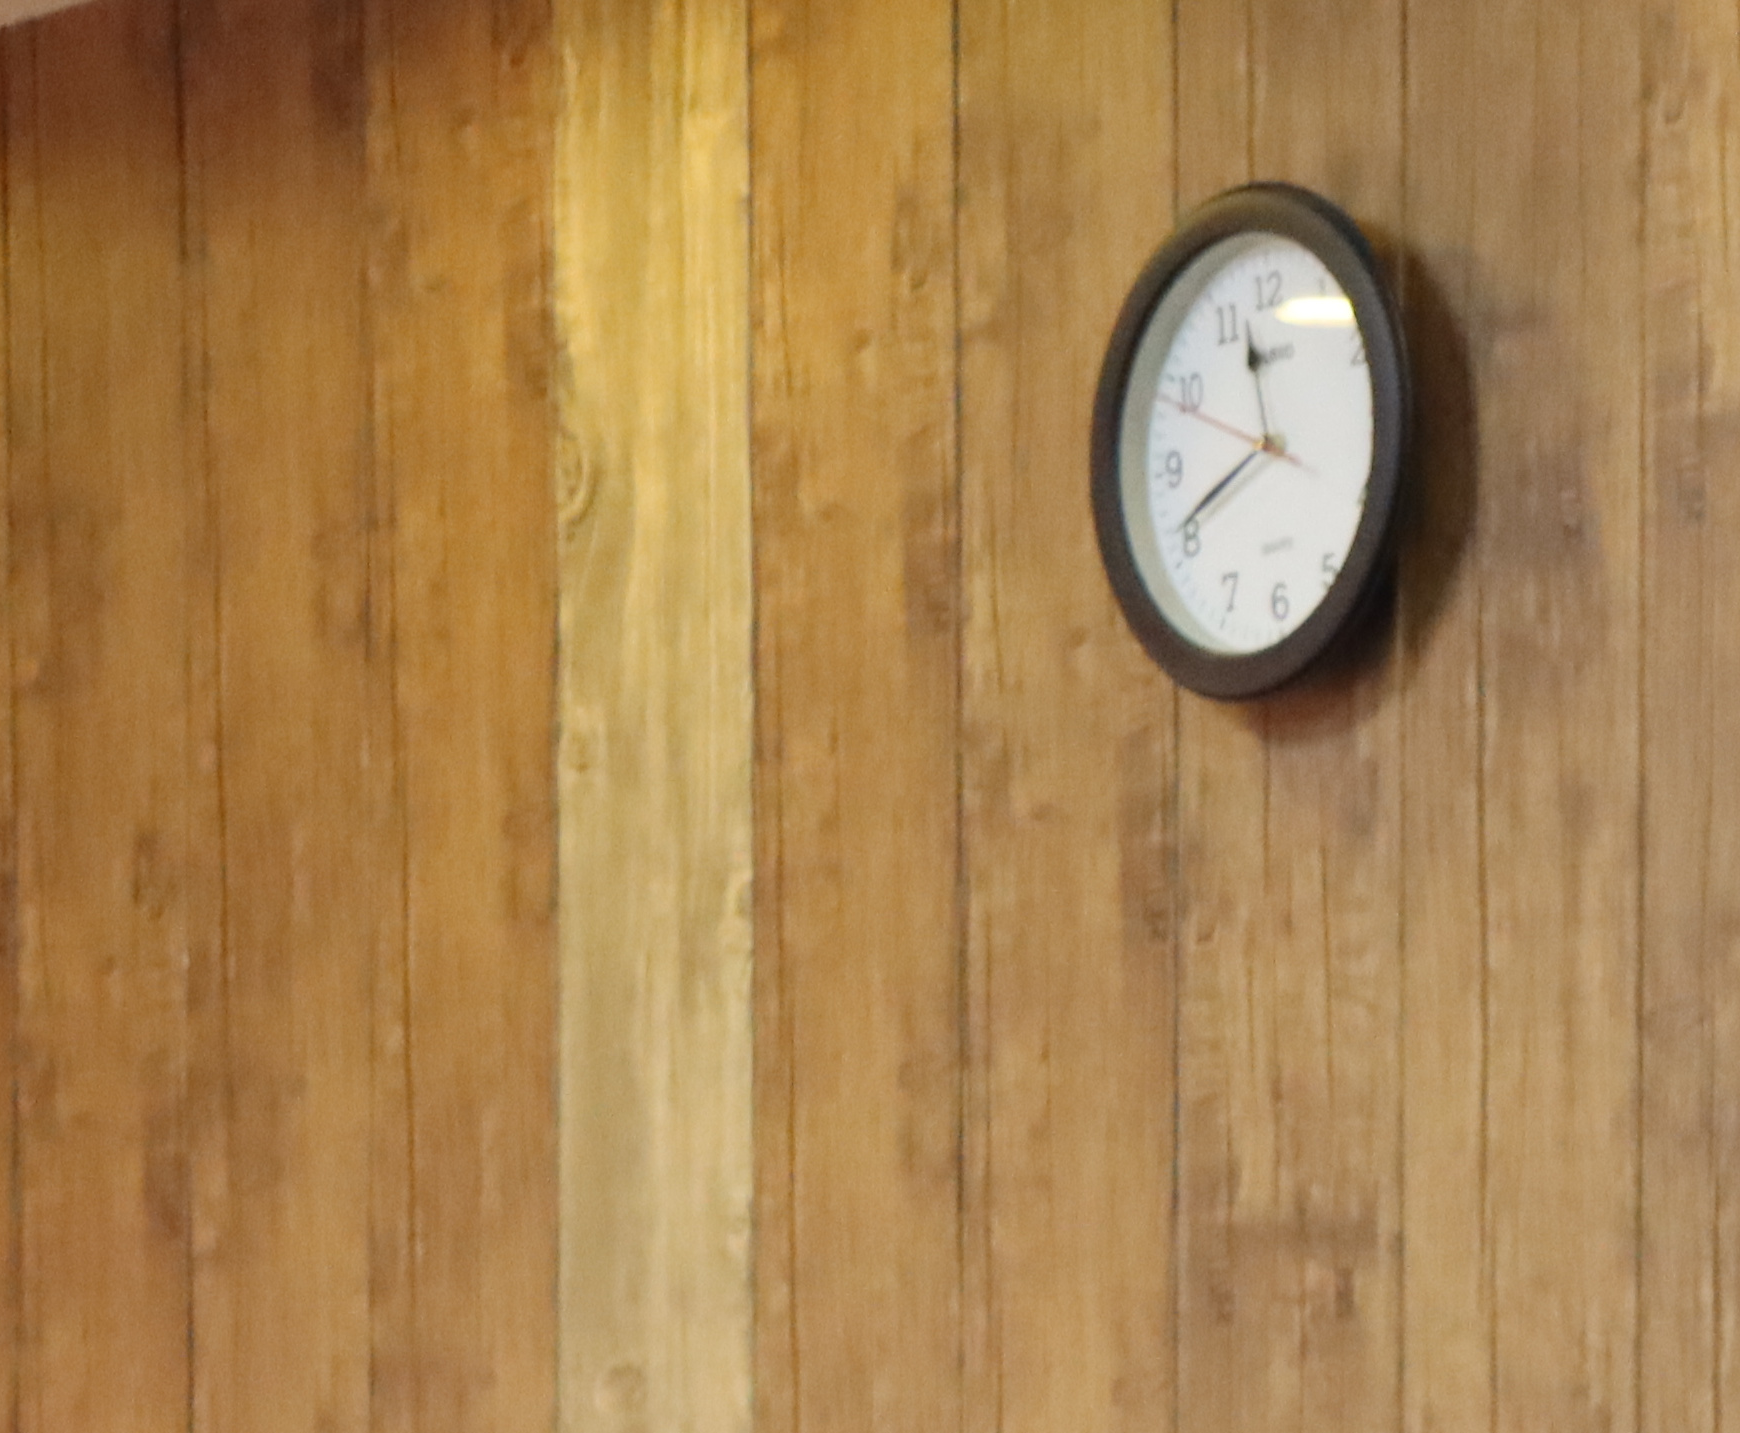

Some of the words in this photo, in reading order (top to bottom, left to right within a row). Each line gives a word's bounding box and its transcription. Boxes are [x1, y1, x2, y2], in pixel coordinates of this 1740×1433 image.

[1254, 270, 1282, 311] 12
[1217, 305, 1240, 346] 11
[1179, 372, 1204, 414] 10
[1167, 450, 1183, 489] 9
[1183, 519, 1202, 558] 8
[1222, 571, 1241, 613] 7
[1271, 583, 1289, 621] 6
